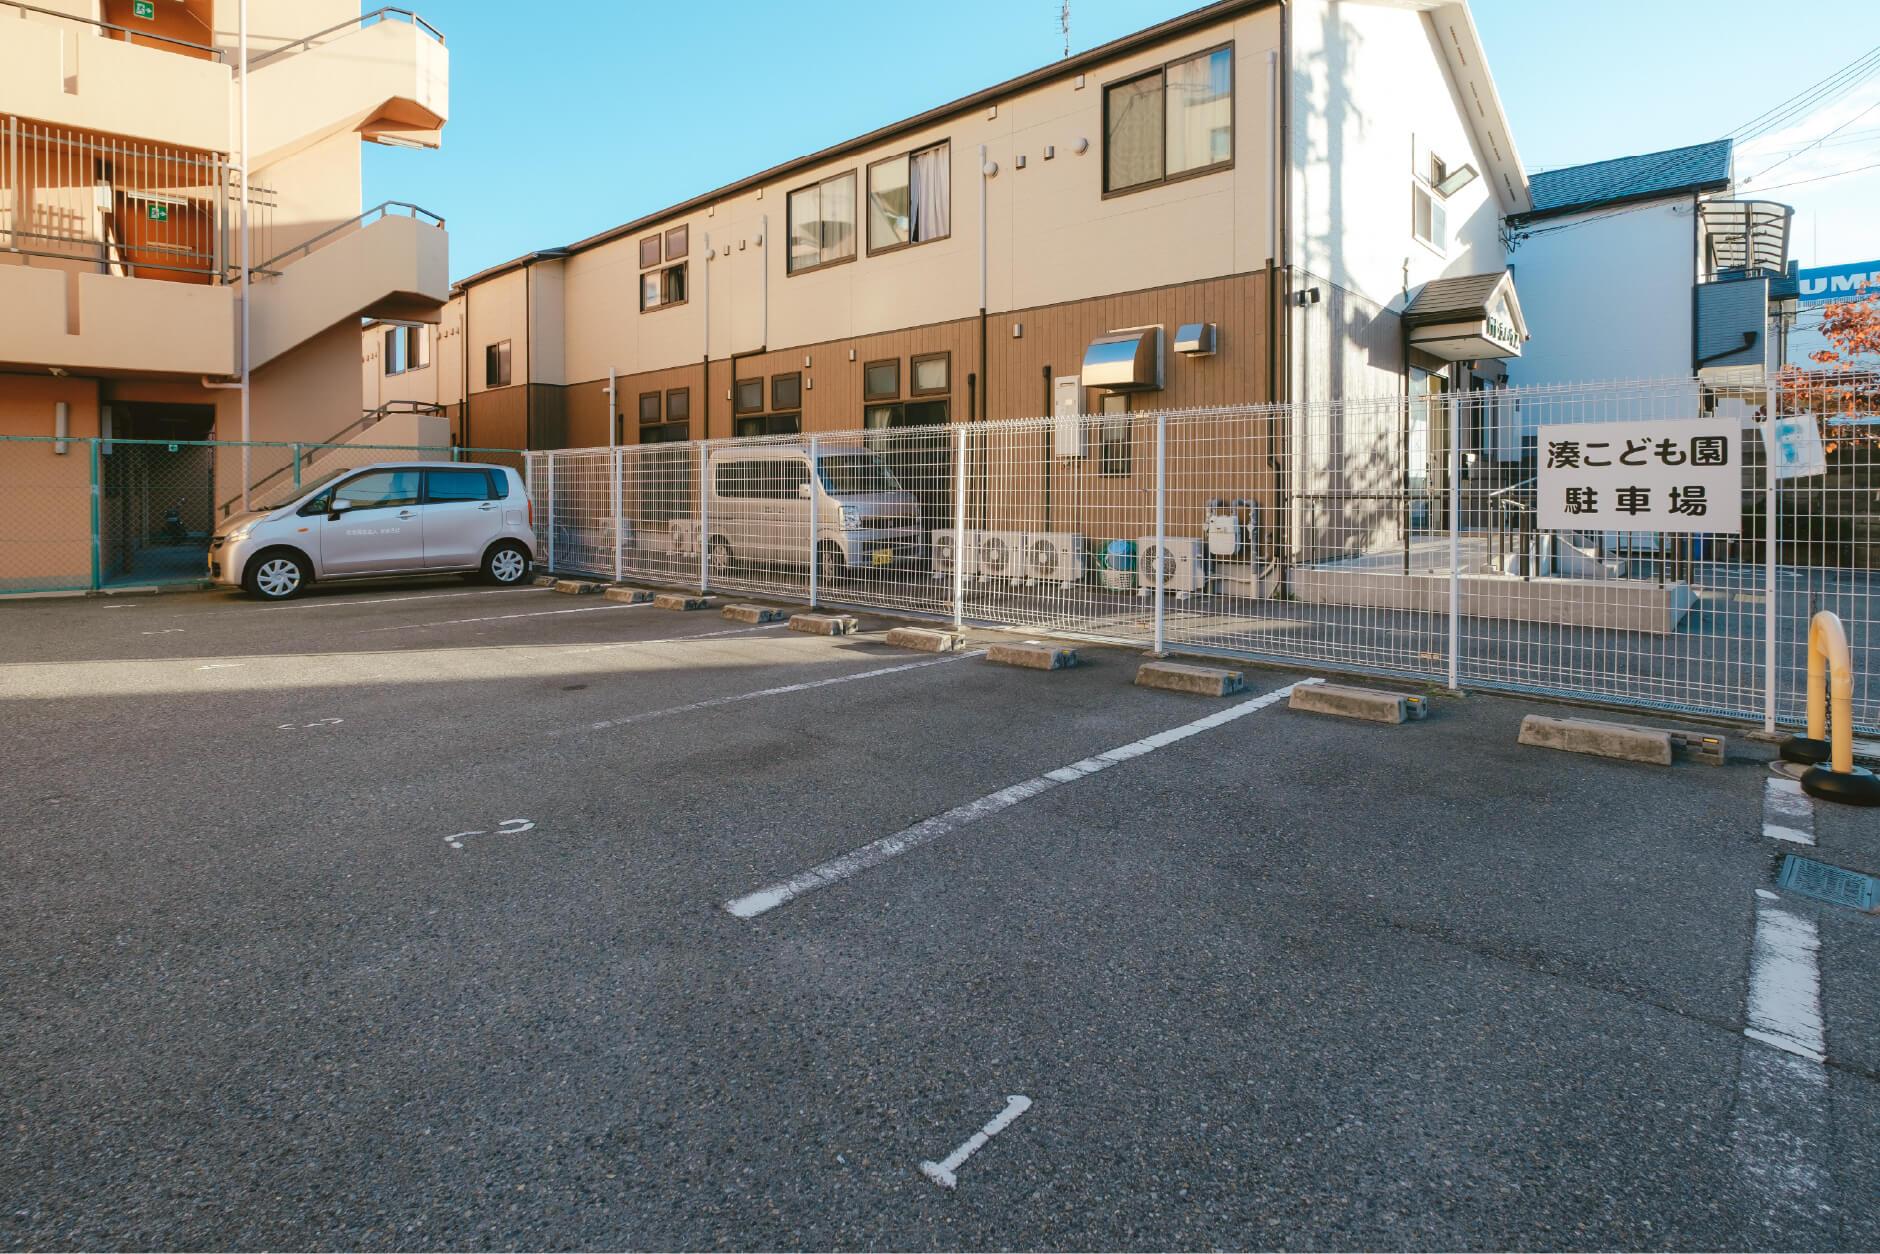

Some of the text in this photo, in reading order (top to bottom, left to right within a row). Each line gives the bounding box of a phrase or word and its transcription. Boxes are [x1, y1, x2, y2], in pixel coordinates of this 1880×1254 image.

[1547, 436, 1729, 469] 湊こども園
[1564, 485, 1708, 516] 駐車場
